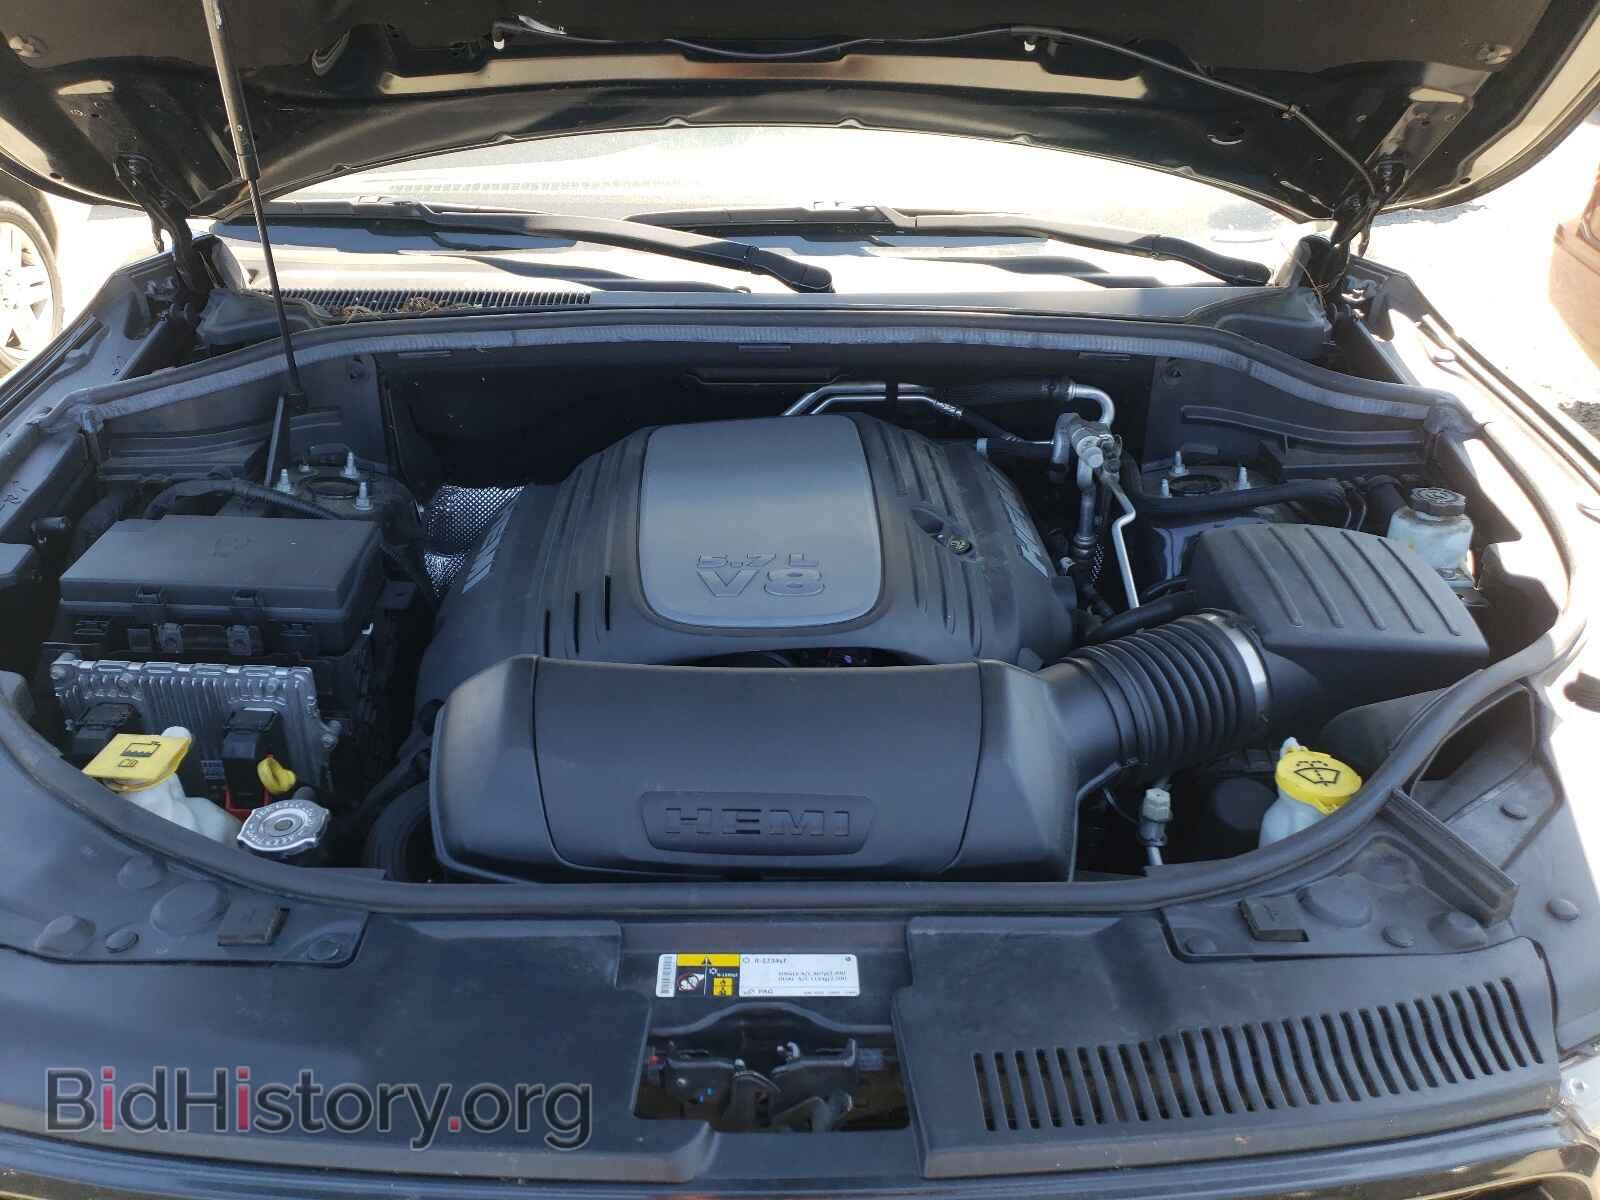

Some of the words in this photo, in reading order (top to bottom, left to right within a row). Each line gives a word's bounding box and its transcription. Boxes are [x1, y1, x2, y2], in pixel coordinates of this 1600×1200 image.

[697, 552, 820, 569] 5.7L
[697, 569, 826, 598] V8
[665, 807, 850, 837] HEMI
